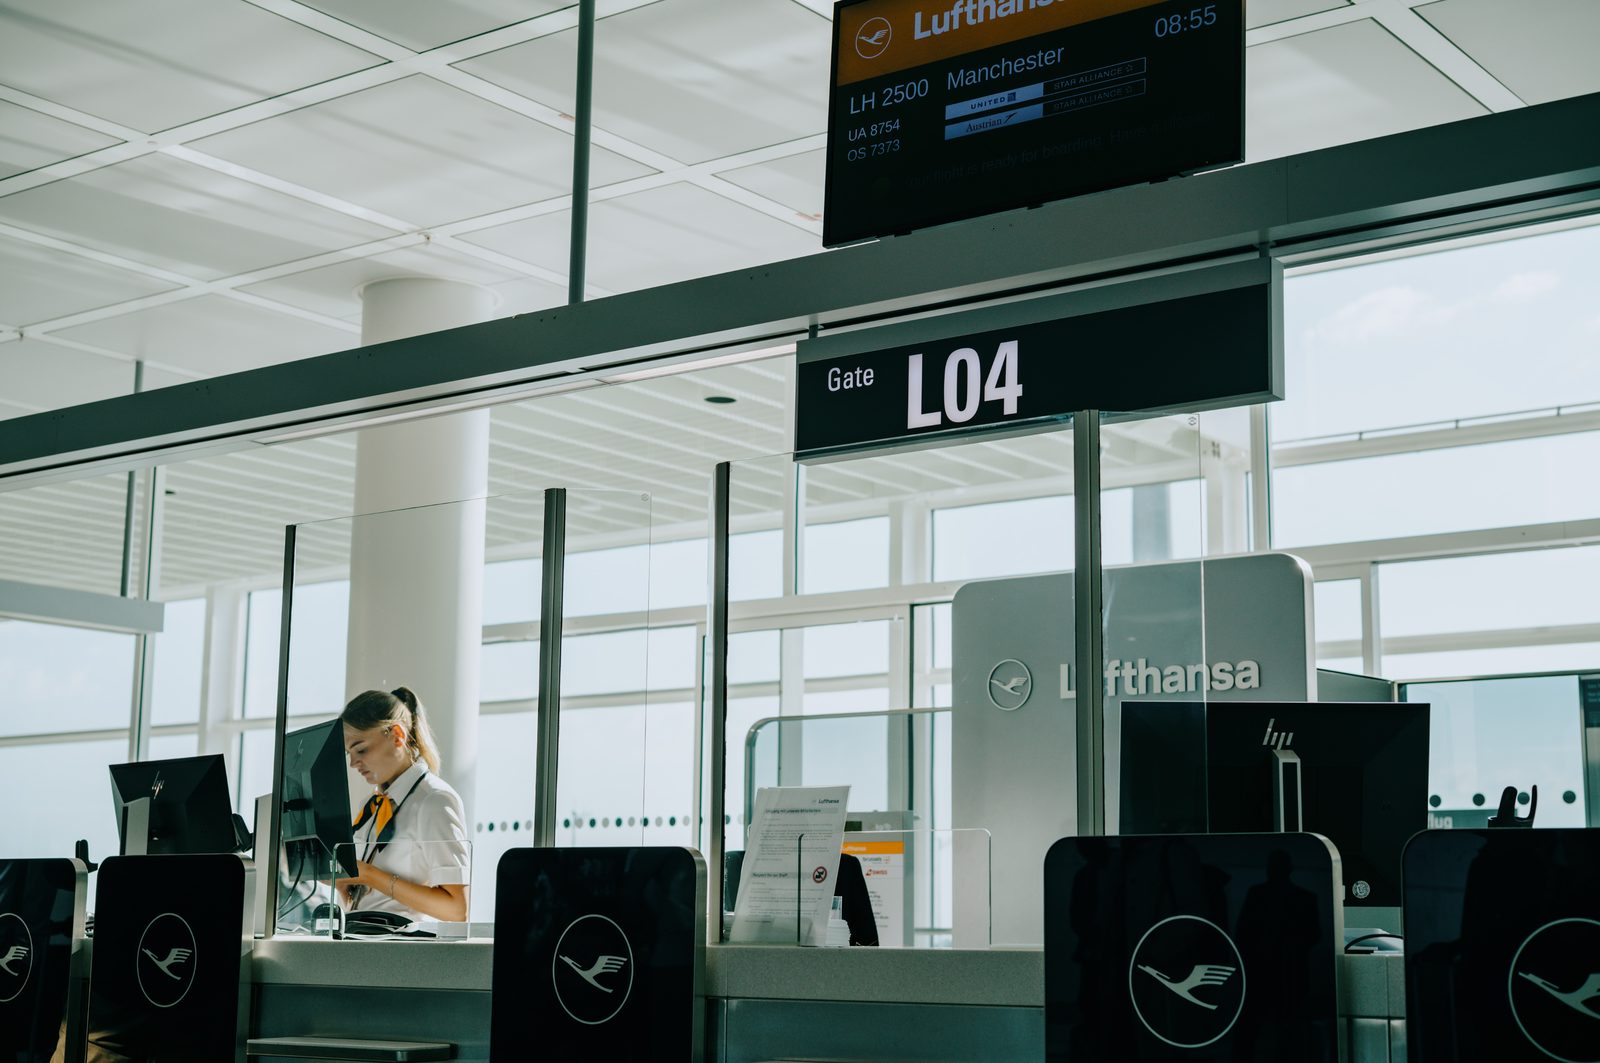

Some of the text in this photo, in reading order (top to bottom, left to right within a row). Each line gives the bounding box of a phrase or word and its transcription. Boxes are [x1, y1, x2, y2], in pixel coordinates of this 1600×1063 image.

[914, 0, 1062, 40] Lufthan
[1154, 4, 1217, 38] 08:55
[947, 47, 1065, 90] Manchester
[1054, 67, 1122, 90] STAR ALLIANCE
[850, 78, 929, 115] LH 2500
[970, 96, 1006, 110] UNITED
[1054, 87, 1122, 111] STAR ALLIANCE
[848, 118, 901, 142] UA 8754
[966, 117, 1002, 133] Austrian
[847, 139, 900, 162] OS 7373
[981, 153, 1018, 173] ready
[1020, 148, 1038, 163] for
[827, 340, 1023, 429] Gate L04
[1060, 658, 1260, 699] Lfthansa
[1262, 718, 1294, 750] hp
